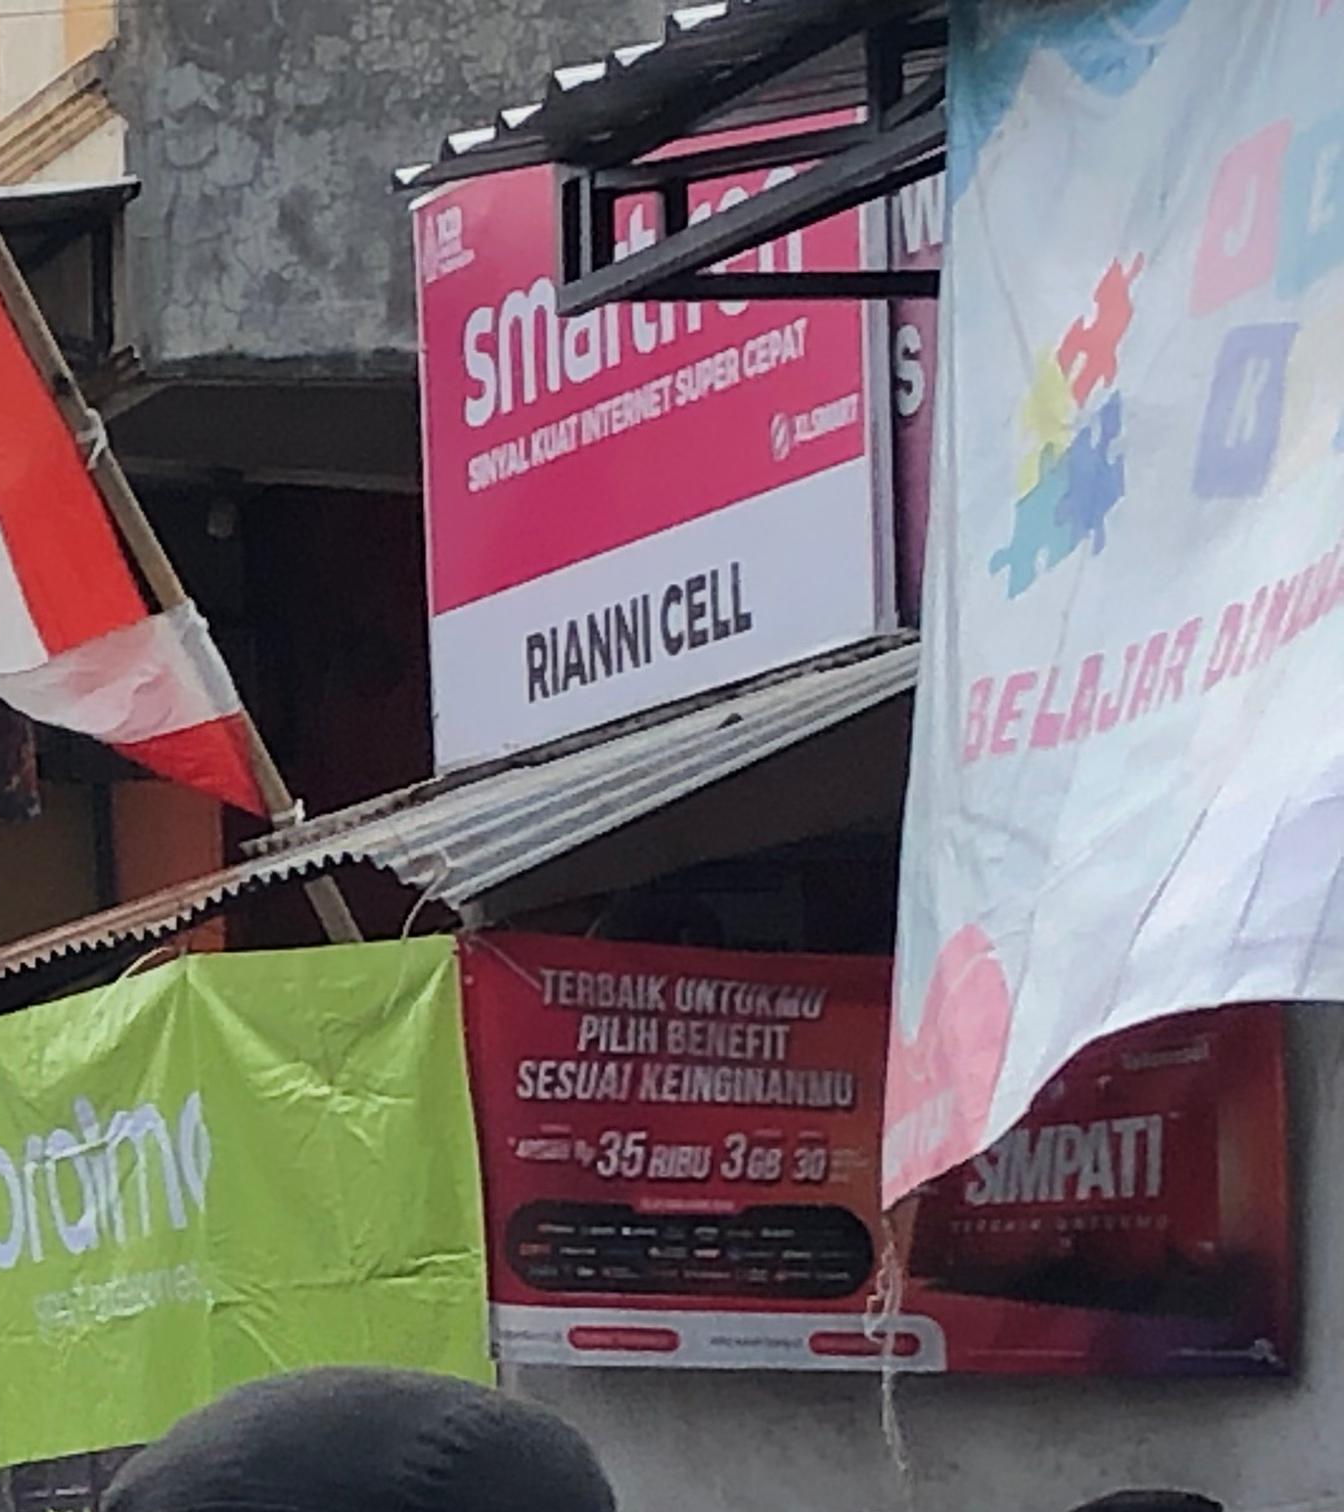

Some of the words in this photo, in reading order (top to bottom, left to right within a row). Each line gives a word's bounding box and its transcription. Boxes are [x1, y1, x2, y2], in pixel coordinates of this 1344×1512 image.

[531, 421, 579, 466] KUAT
[580, 384, 673, 444] INTERNET
[675, 351, 741, 407] SUPER
[743, 318, 808, 378] CEPAT
[526, 595, 651, 703] RIANNI
[660, 562, 752, 656] CELL
[963, 616, 1202, 766] BELAJAR
[539, 968, 668, 1011] TERBAIK
[674, 977, 826, 1020] UNTUKMU
[578, 1015, 659, 1054] PILIH
[666, 1020, 791, 1061] BENEFIT
[517, 1060, 636, 1100] SESUAI
[639, 1062, 855, 1107] KEINGINANMU
[596, 1130, 648, 1178] 35
[647, 1145, 712, 1179] RIBU
[720, 1133, 746, 1179] 3
[965, 1114, 1162, 1206] SIMPATI
